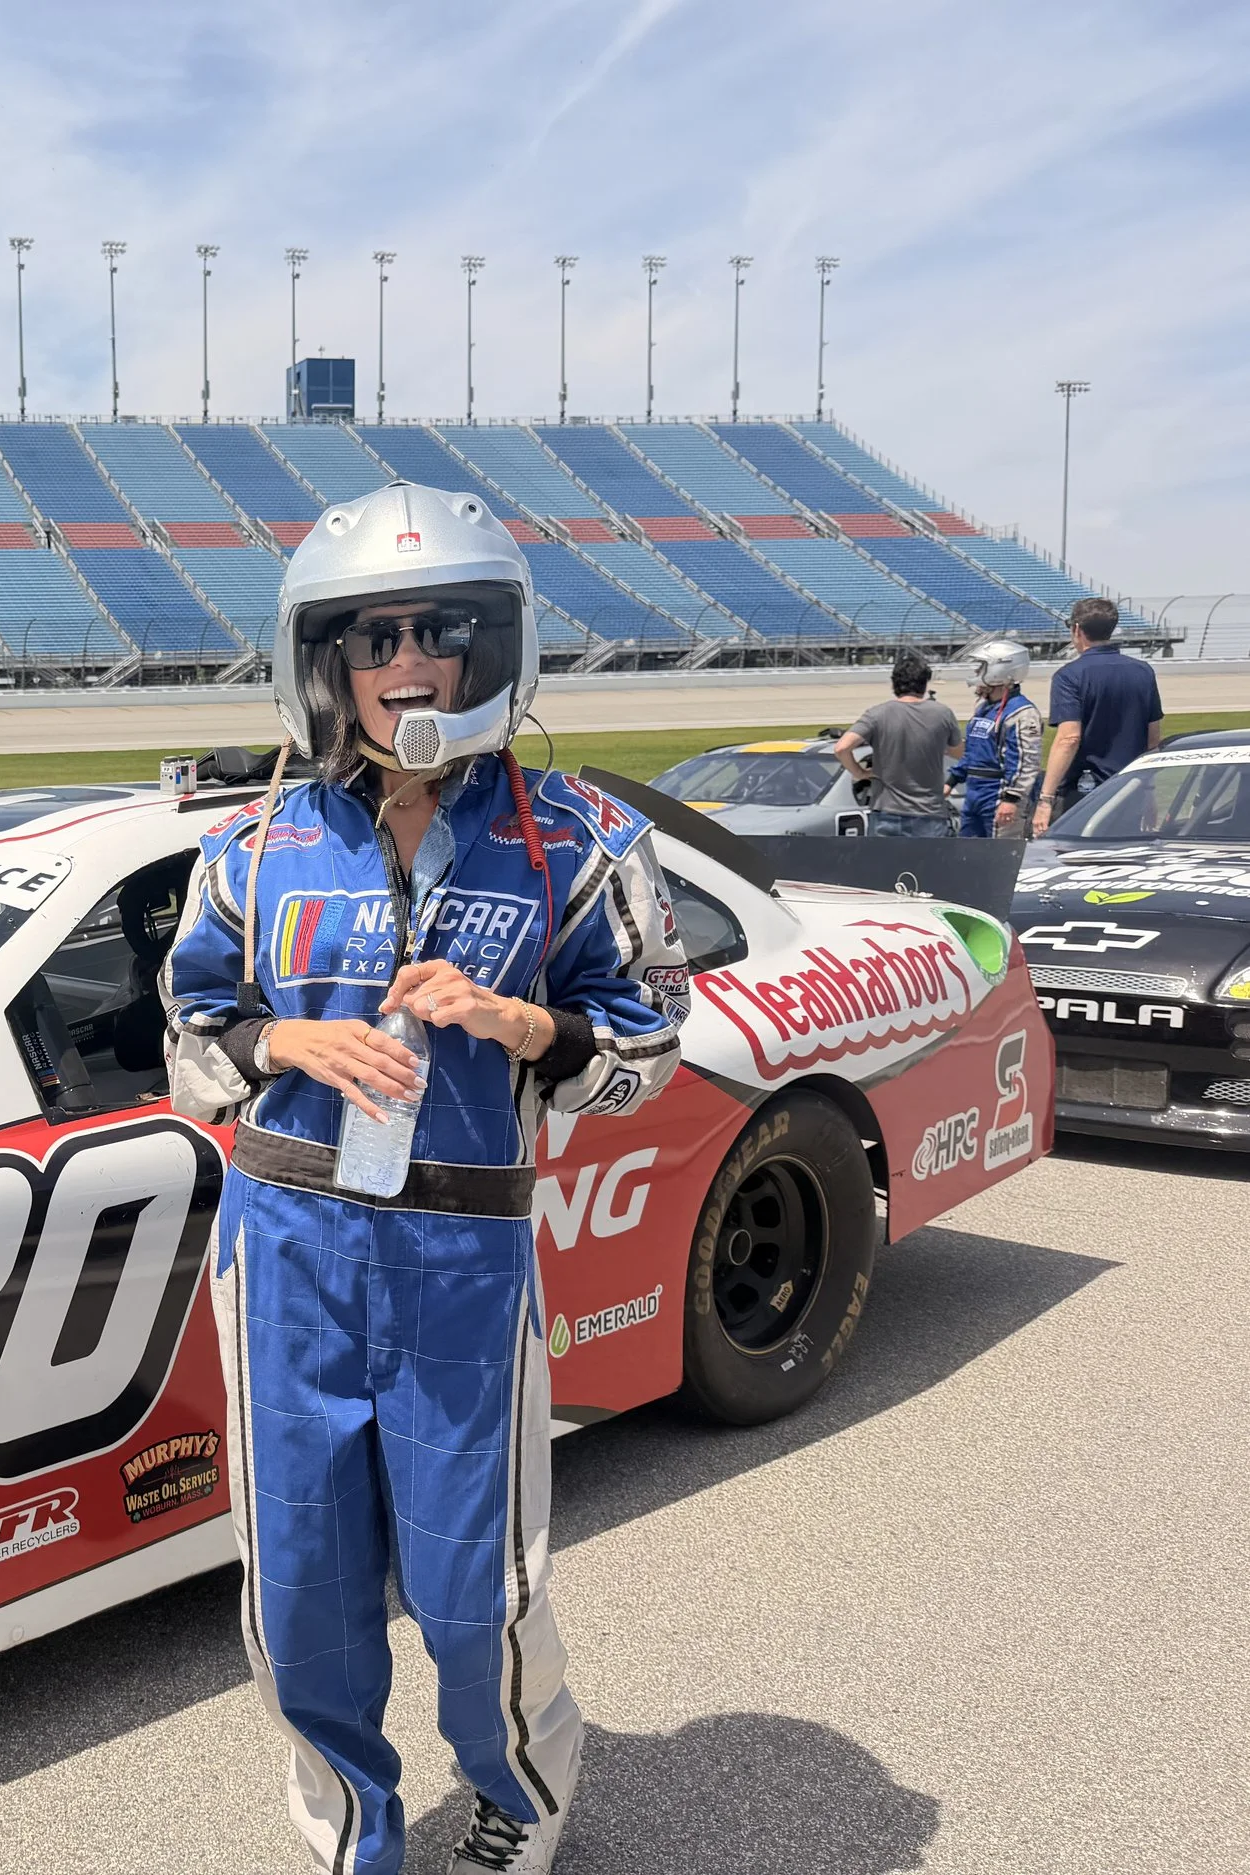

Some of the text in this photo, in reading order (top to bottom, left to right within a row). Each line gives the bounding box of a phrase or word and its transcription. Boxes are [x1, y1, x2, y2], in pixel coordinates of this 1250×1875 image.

[353, 899, 519, 939] NACAR
[346, 937, 504, 960] RAING
[693, 937, 971, 1072] CleanHarbors
[22, 1034, 42, 1070] NASCAR
[776, 1286, 791, 1308] AERO
[577, 1295, 657, 1342] EMERALD
[124, 1432, 220, 1483] MURPHY'S
[126, 1467, 218, 1512] WASTE OIL SERVICE
[12, 1522, 78, 1552] RECYCLERS
